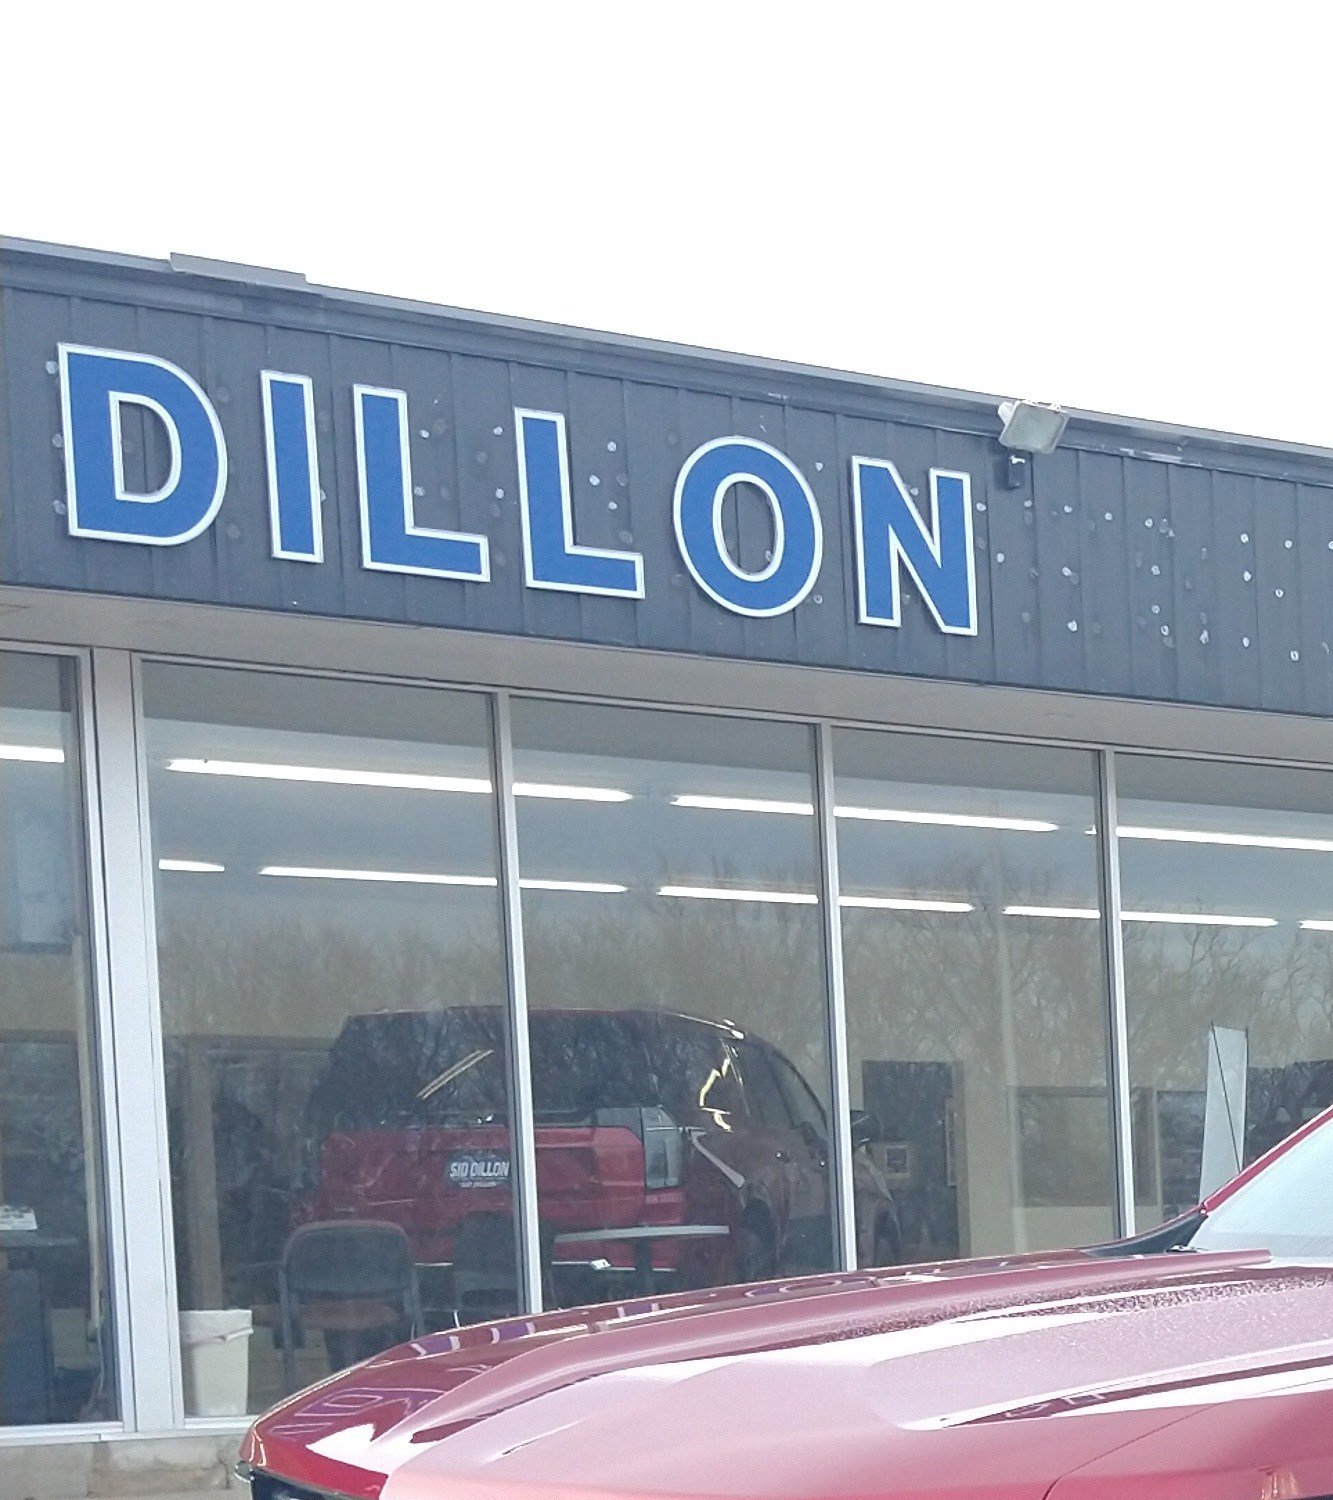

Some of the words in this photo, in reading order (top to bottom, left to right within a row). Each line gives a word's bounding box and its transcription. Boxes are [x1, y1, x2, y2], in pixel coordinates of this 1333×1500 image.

[57, 342, 979, 636] DILLON
[450, 1161, 468, 1177] SID
[470, 1161, 510, 1177] DILLON
